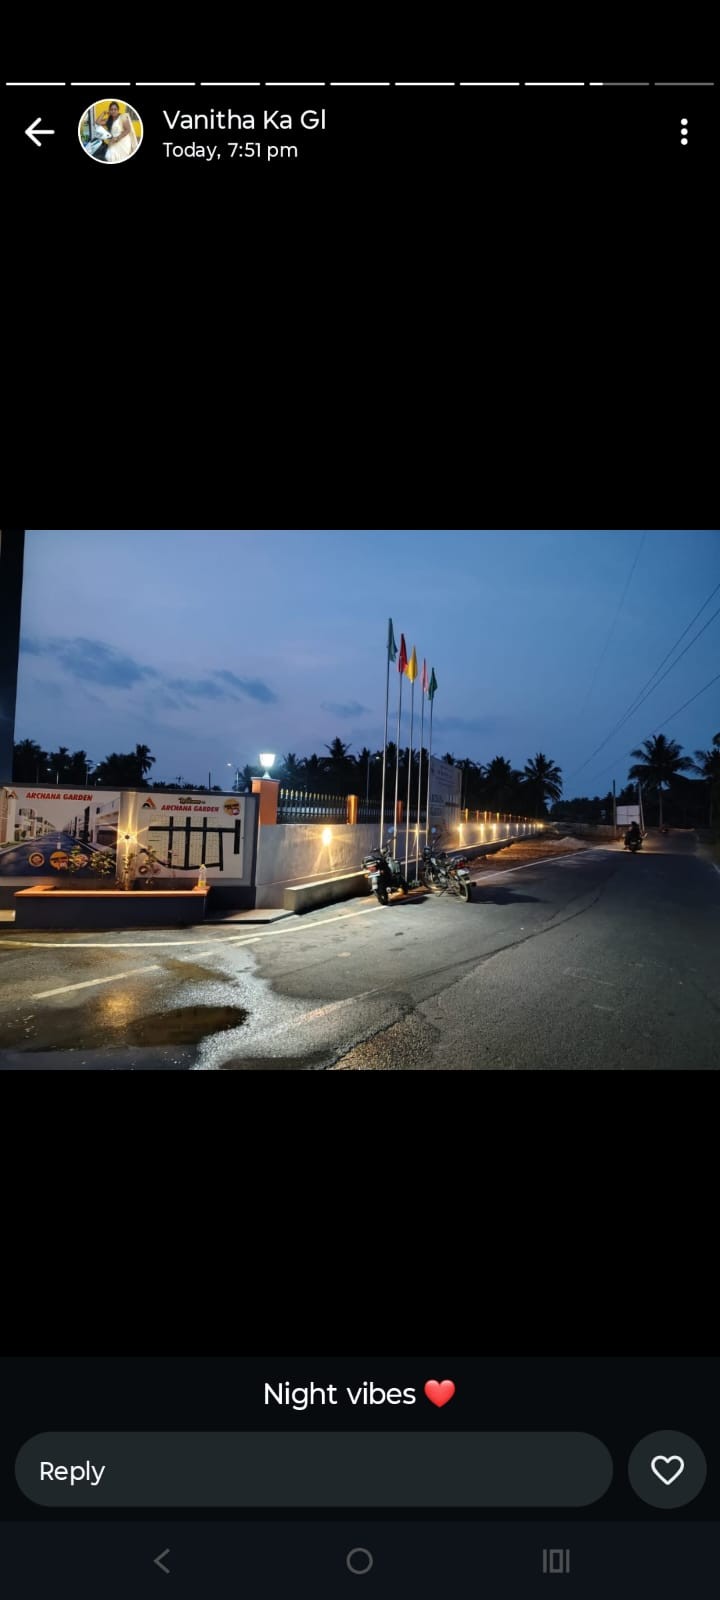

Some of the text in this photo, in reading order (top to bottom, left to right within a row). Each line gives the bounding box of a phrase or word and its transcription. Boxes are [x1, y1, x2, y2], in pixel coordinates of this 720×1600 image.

[26, 792, 93, 801] ARCHANA GARDEN
[161, 804, 192, 812] ARCHANA
